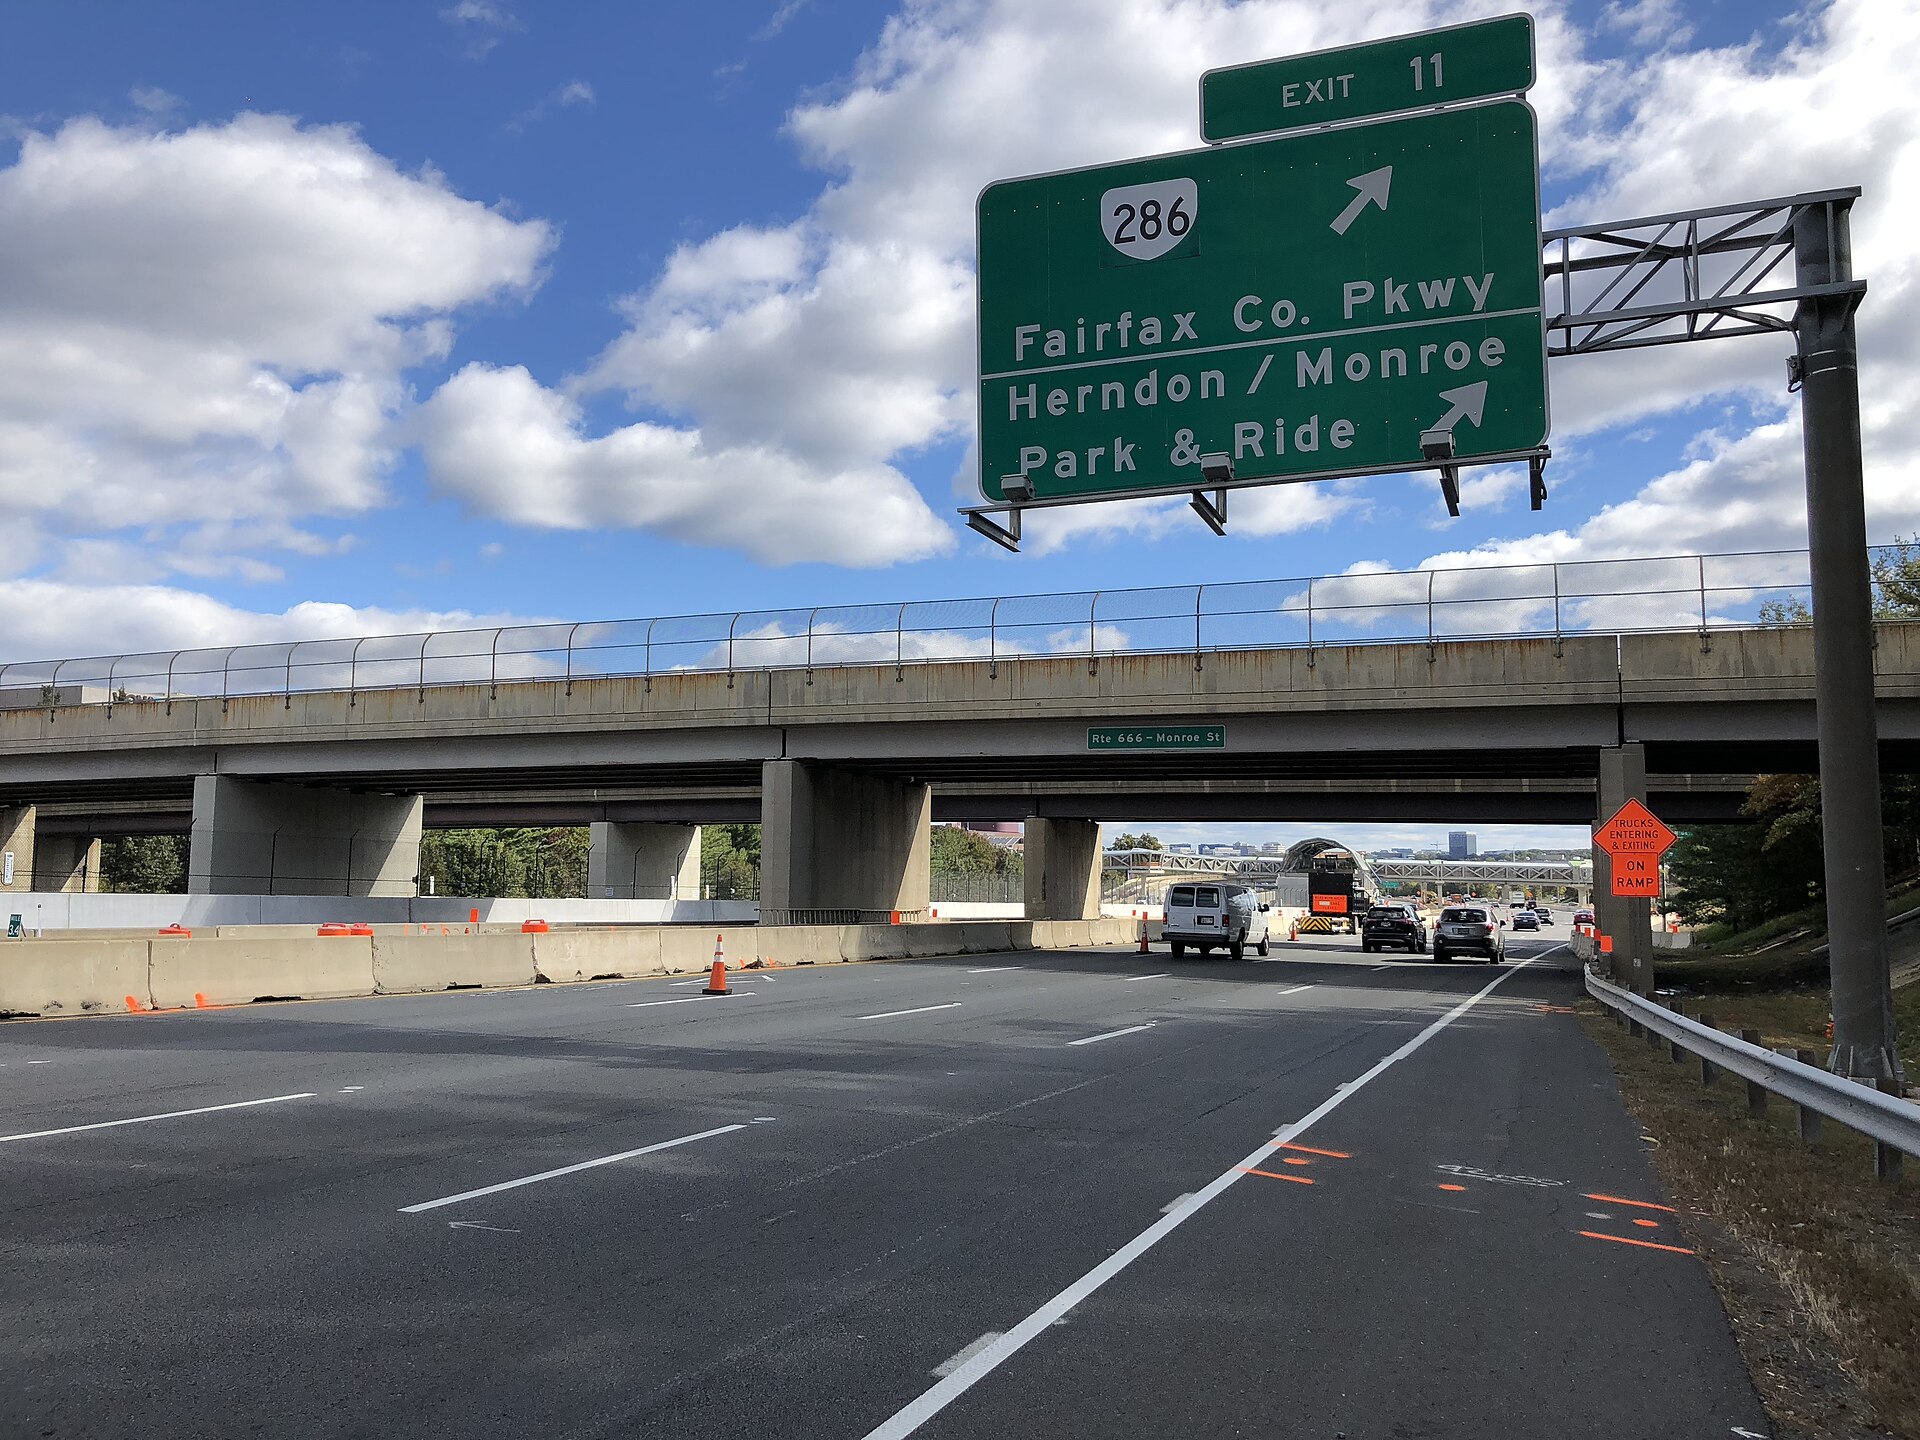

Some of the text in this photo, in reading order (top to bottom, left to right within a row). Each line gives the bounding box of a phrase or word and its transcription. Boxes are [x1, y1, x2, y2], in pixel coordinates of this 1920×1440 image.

[1282, 52, 1444, 108] EXIT 11
[1112, 196, 1191, 245] 286
[1015, 272, 1495, 361] Fairfax Co. Pkwy
[1008, 367, 1226, 421] Herndon
[1296, 336, 1506, 388] Monroe
[1020, 416, 1356, 479] Park & Ride
[1092, 734, 1112, 744] Rte
[1206, 731, 1220, 742] St
[1617, 878, 1653, 887] RAMP
[1627, 861, 1644, 870] ON
